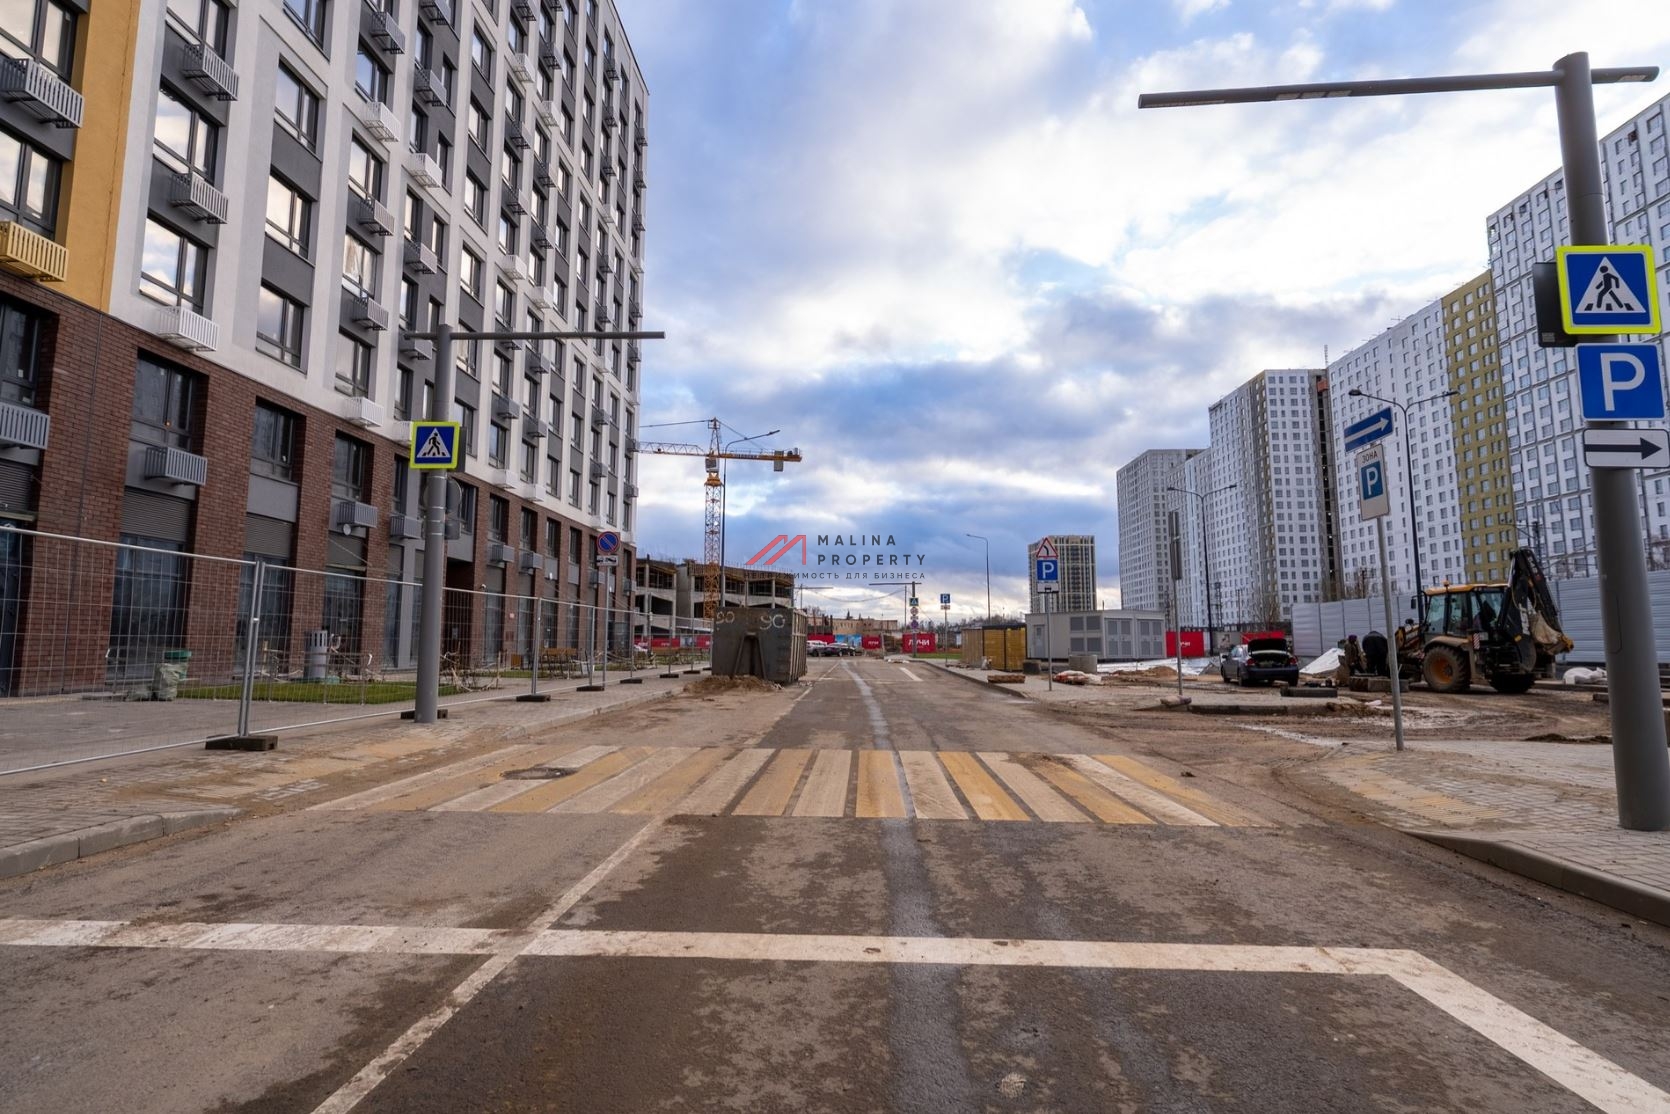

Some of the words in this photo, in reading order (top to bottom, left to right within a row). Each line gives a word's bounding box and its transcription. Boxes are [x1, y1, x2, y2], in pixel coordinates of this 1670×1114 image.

[1600, 352, 1645, 411] P
[1361, 450, 1378, 464] ЗОНА
[1366, 466, 1379, 496] P
[1042, 562, 1054, 579] P
